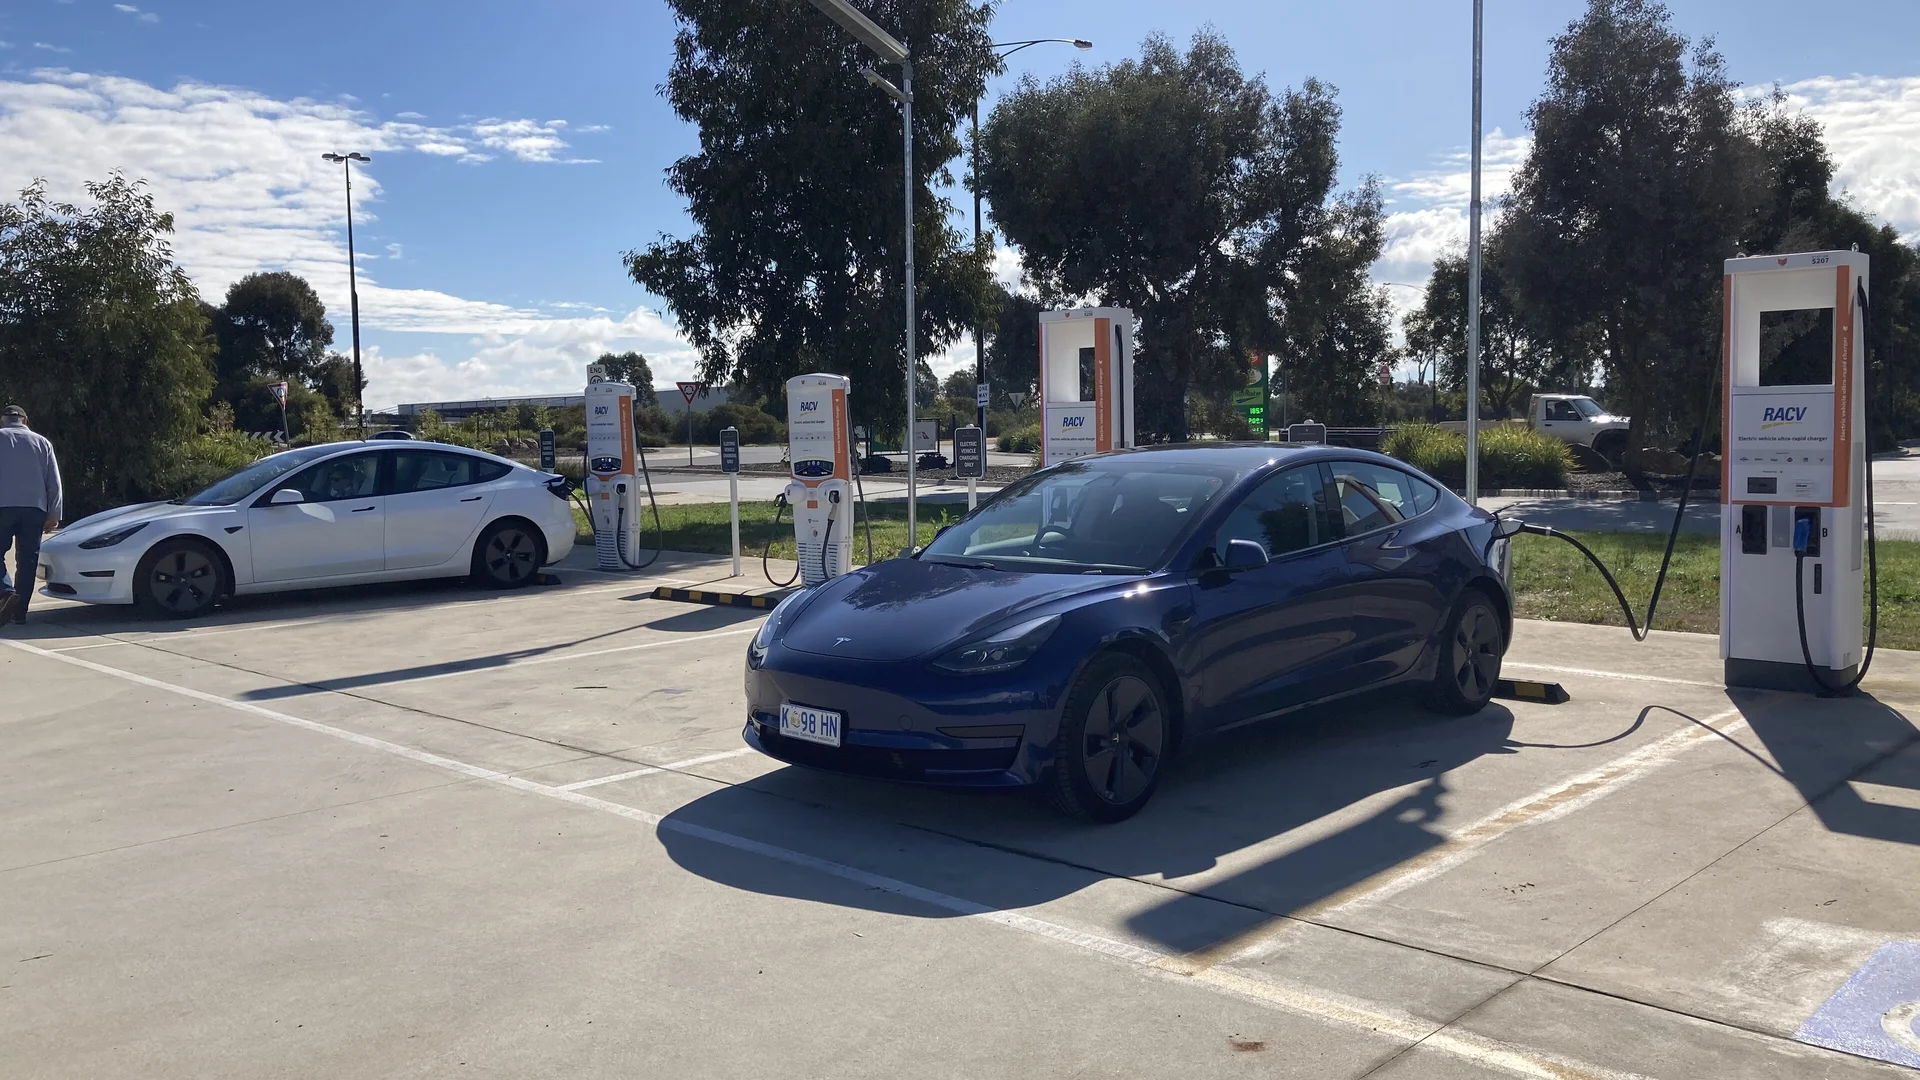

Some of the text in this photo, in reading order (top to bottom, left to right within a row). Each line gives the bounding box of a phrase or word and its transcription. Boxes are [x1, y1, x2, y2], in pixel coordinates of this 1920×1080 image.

[594, 406, 609, 415] RACV
[800, 401, 818, 411] RACV
[1763, 406, 1808, 421] RACV
[1062, 416, 1085, 427] RACV
[1735, 525, 1742, 534] A
[1822, 528, 1828, 537] B
[781, 707, 838, 738] K 98 HN
